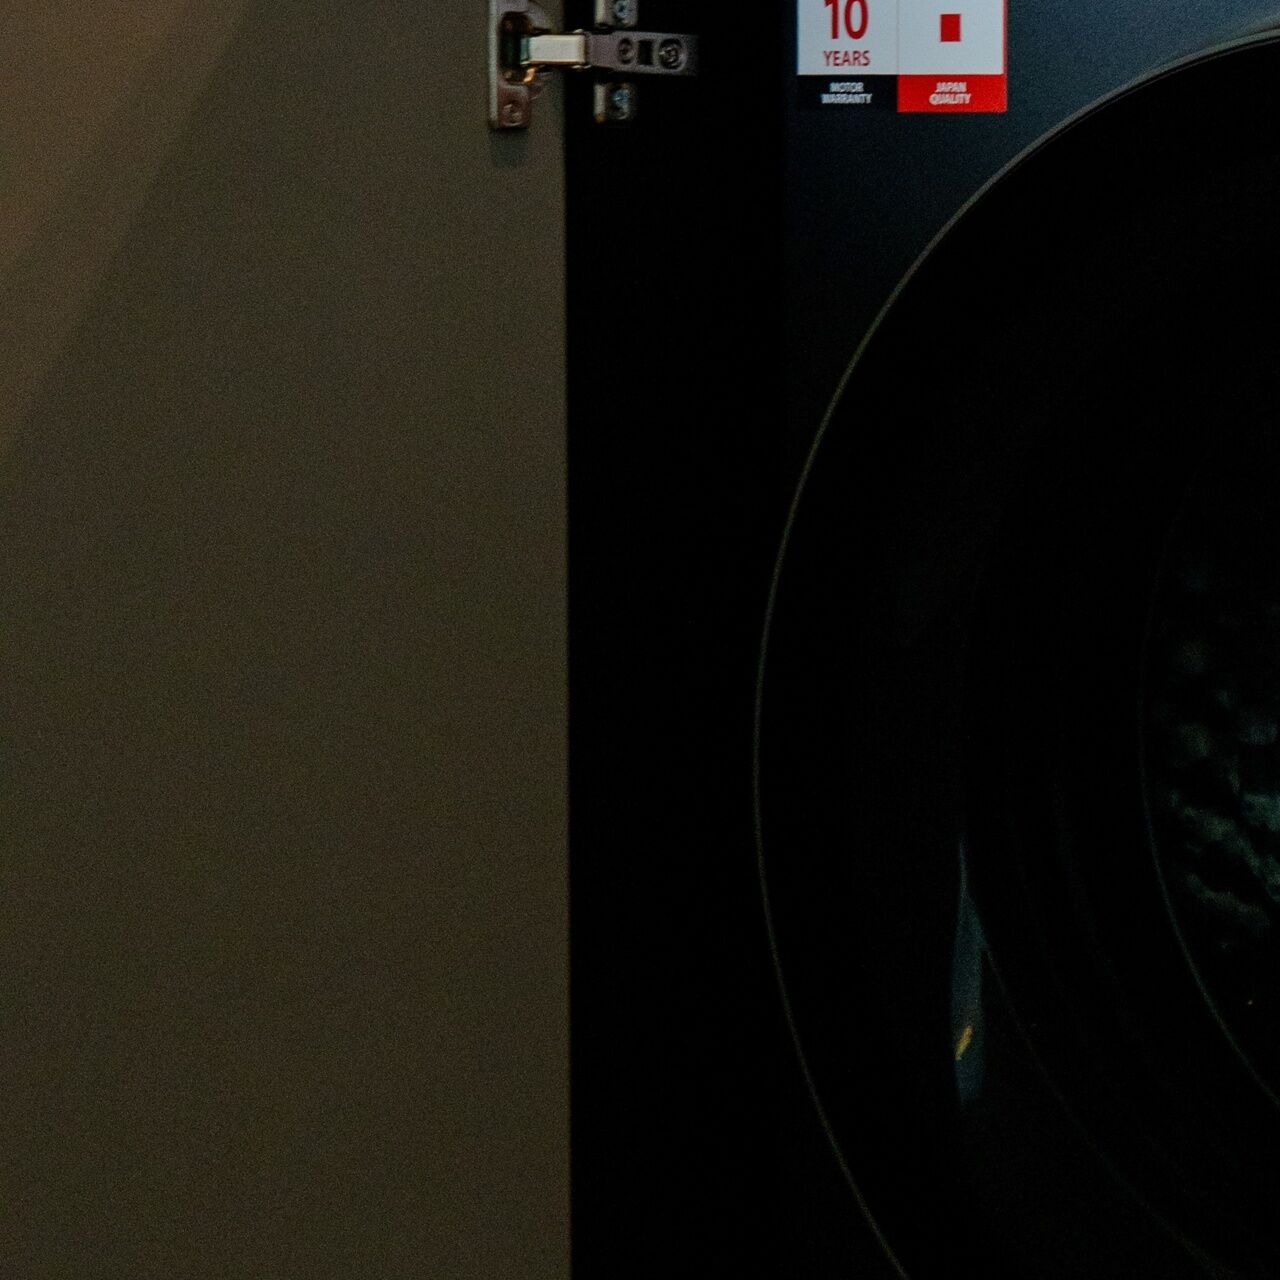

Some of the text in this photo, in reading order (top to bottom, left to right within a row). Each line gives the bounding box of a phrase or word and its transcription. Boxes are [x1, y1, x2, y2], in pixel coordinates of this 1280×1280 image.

[824, 50, 870, 66] YEARS
[829, 81, 864, 93] MOTOR
[936, 81, 967, 93] JAPAN
[820, 92, 872, 104] WARRANTY
[928, 93, 971, 105] QUALITY
